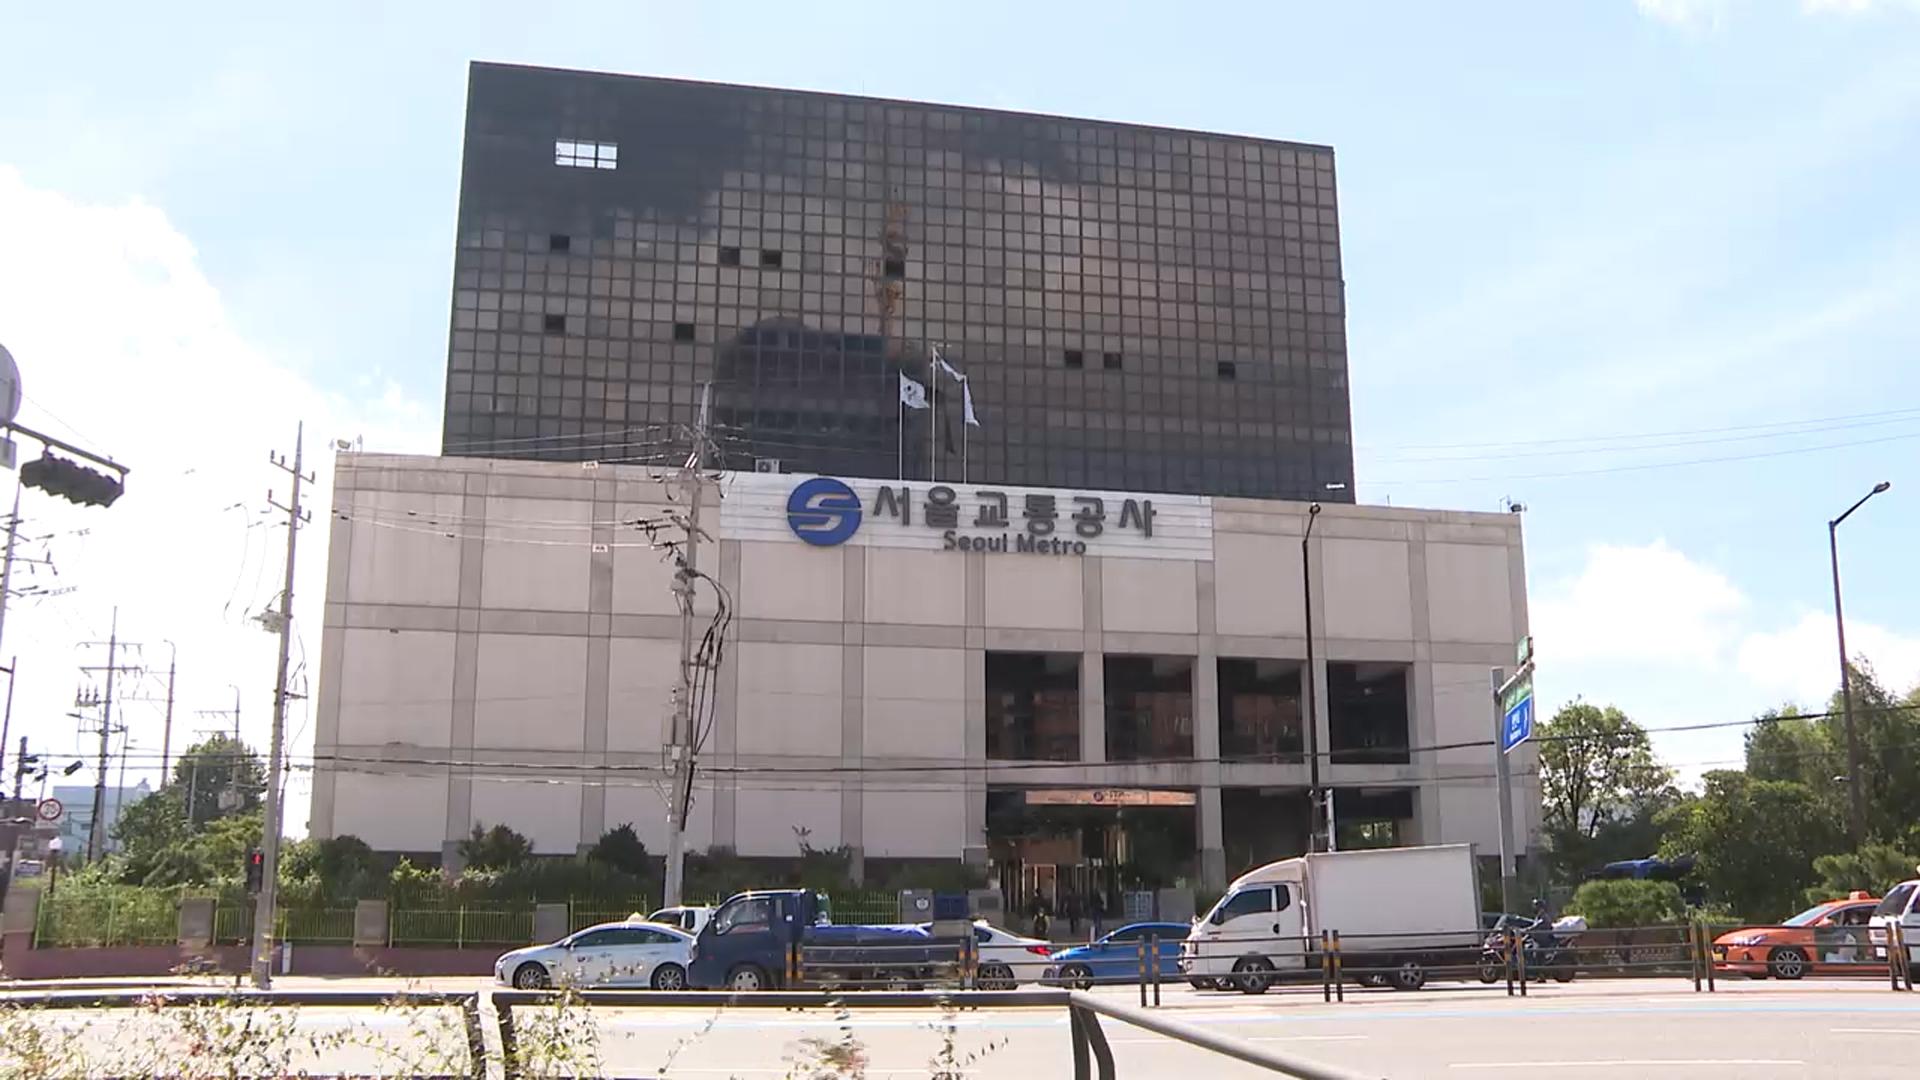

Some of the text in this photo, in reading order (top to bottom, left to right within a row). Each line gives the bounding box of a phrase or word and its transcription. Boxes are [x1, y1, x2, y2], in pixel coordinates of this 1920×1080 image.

[873, 485, 1157, 540] 서울교통공사
[943, 529, 1087, 557] Seoul Metro
